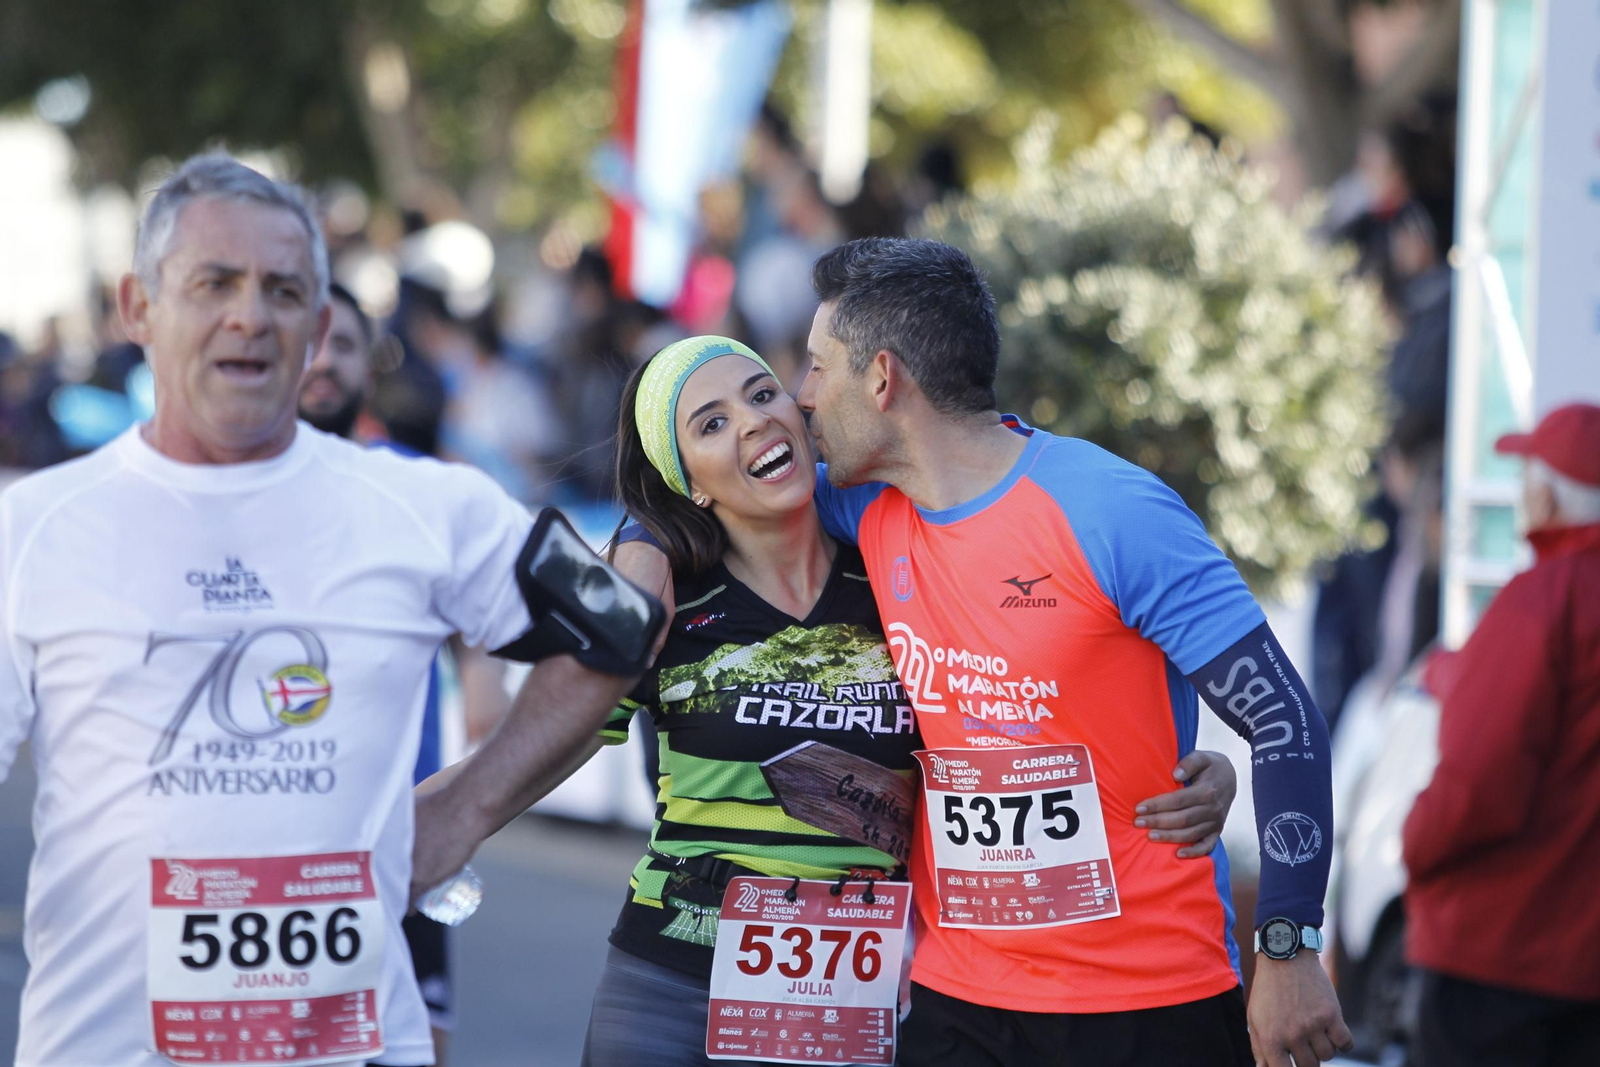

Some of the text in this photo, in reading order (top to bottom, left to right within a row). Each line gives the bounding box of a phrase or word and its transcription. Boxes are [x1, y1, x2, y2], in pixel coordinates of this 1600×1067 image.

[999, 595, 1057, 608] MIZUNO
[1261, 640, 1276, 663] TRAIL
[947, 648, 1008, 676] MEDIO
[1274, 661, 1289, 686] ULTRA
[144, 625, 329, 766] 70
[948, 674, 1059, 700] MARATÓN
[735, 696, 914, 739] CAZORLA
[957, 699, 1054, 722] ALMERÍA
[194, 740, 336, 763] 1949-2019
[949, 760, 969, 768] MEDIO
[1013, 754, 1074, 769] CARRERA
[950, 768, 982, 777] MARATÓN
[952, 777, 980, 785] ALMERÍA
[1001, 768, 1078, 785] SALUDABLE
[148, 768, 336, 797] ANIVERSARIO
[944, 789, 1080, 846] 5375
[980, 848, 1035, 862] JUANRA
[301, 863, 361, 879] CARRERA
[283, 880, 363, 898] SALUDABLE
[842, 893, 895, 906] CARERA
[762, 913, 795, 921] 03/02/2019
[763, 906, 801, 916] ALMERÍA
[827, 907, 894, 920] SALUDABLE
[180, 907, 360, 970] 5866
[736, 924, 882, 982] 5376
[232, 972, 308, 988] JUANJO
[787, 981, 833, 996] JULIA
